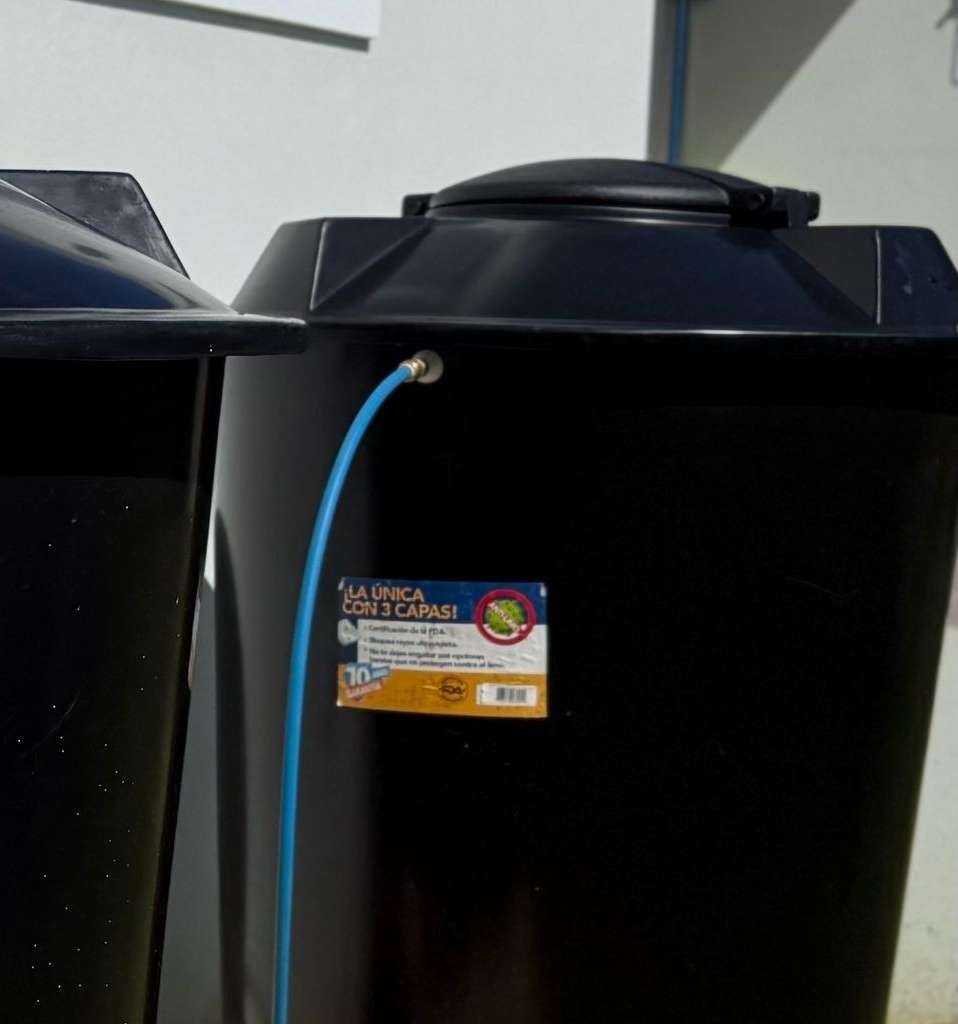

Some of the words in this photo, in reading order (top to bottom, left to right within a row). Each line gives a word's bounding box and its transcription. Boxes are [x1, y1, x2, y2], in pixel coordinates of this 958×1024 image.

[371, 582, 425, 602] ÚNICA
[342, 600, 377, 616] CON
[381, 602, 391, 617] 3
[395, 603, 458, 620] CAPAS!
[345, 663, 371, 686] 10
